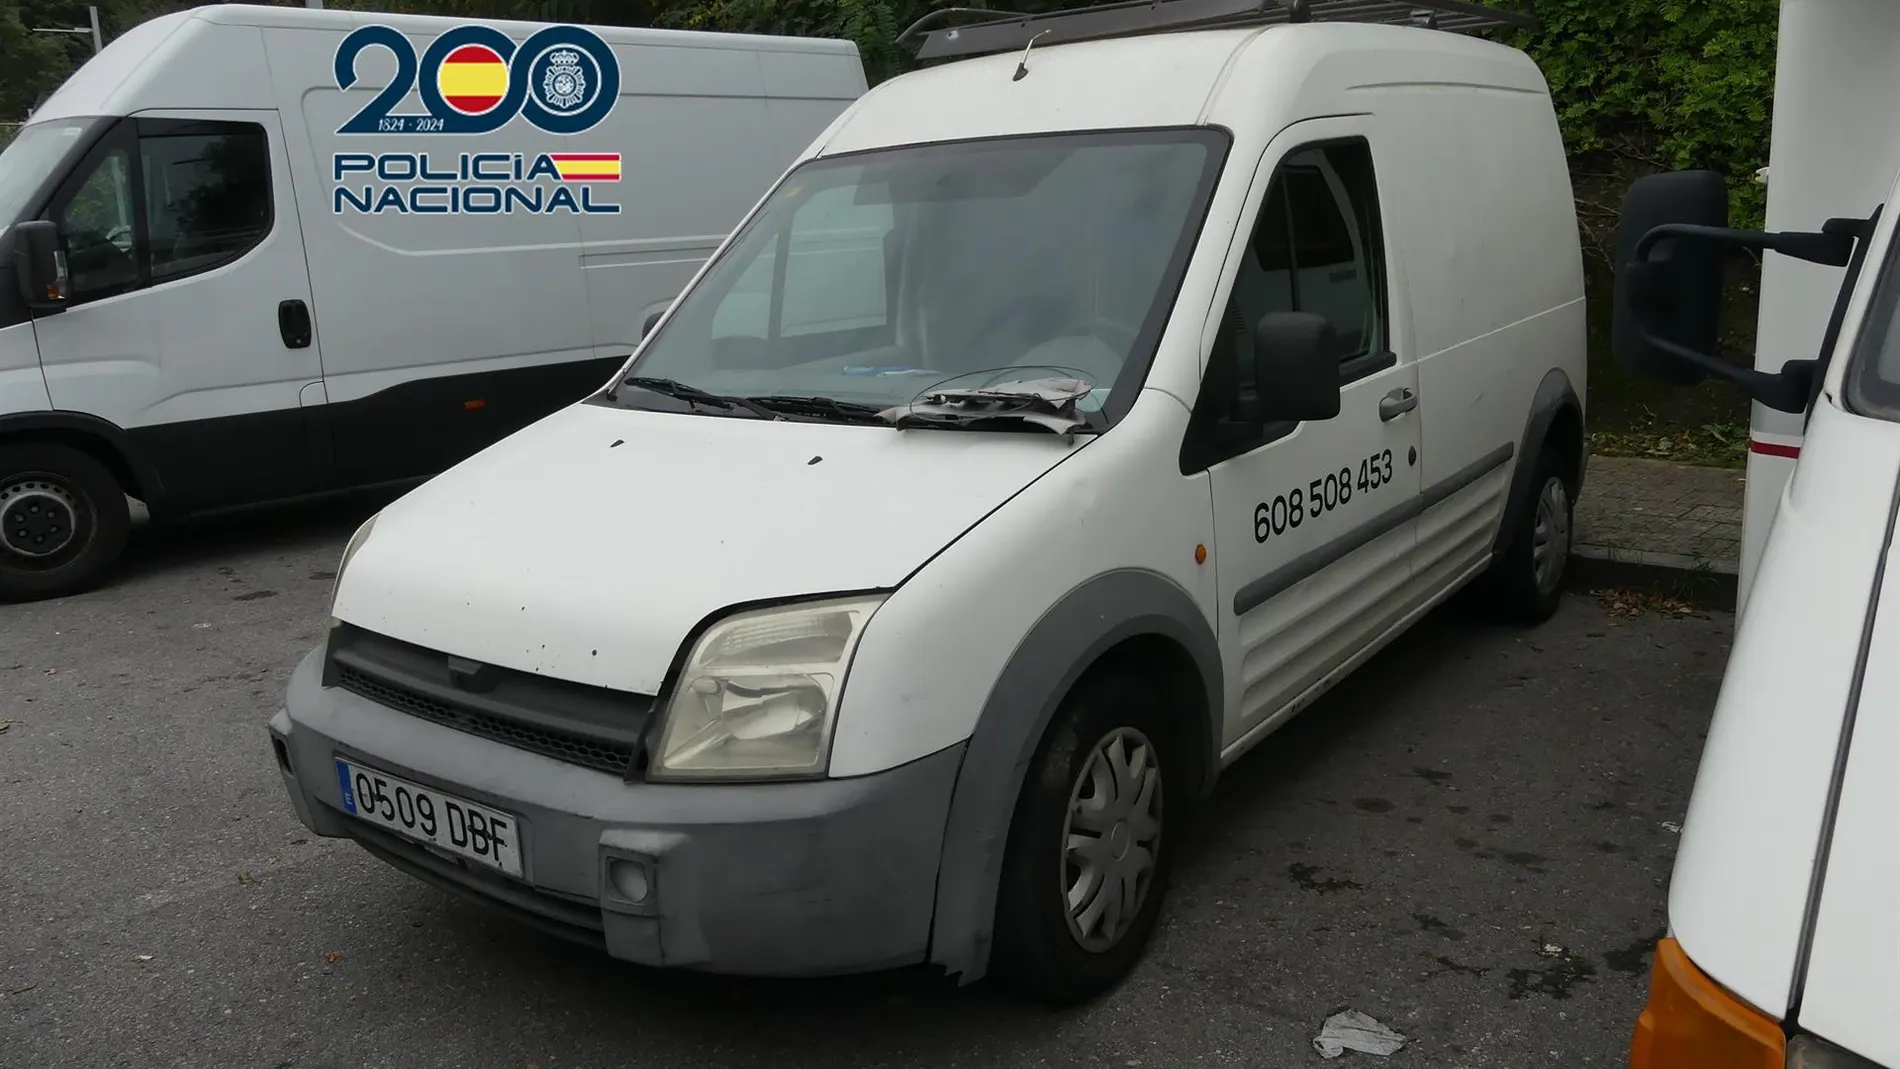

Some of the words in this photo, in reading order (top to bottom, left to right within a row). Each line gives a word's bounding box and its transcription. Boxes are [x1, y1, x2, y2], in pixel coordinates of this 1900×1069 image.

[1254, 488, 1304, 544] 608
[1309, 467, 1352, 518] 508
[1357, 449, 1392, 493] 453
[355, 772, 437, 836] 0509
[446, 801, 508, 862] DBF
